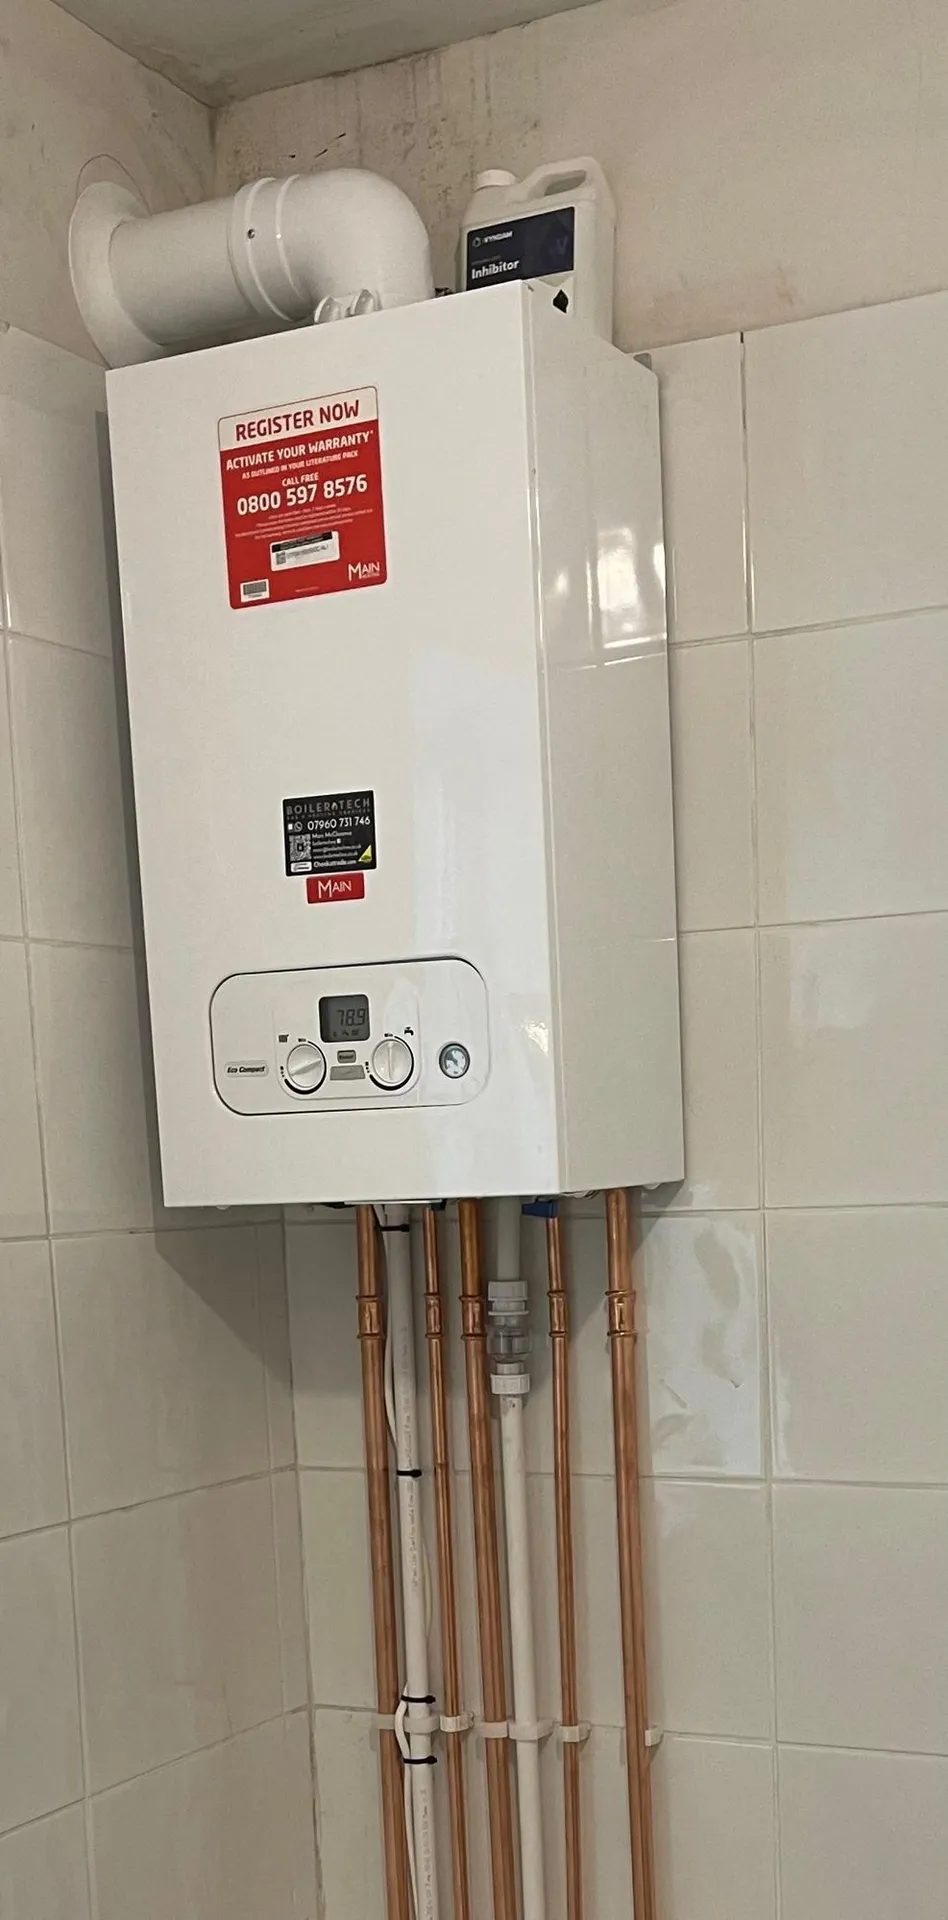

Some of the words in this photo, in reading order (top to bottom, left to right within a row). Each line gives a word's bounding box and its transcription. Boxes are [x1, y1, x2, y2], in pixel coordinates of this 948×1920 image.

[471, 260, 520, 279] Inhibitor
[235, 409, 314, 442] REGISTER
[319, 399, 360, 424] NOW
[226, 450, 275, 471] ACTIVATE
[277, 444, 306, 460] YOUR
[242, 472, 251, 480] AS
[251, 466, 280, 479] OUTLINED
[281, 464, 288, 472] IN
[288, 461, 305, 471] YOUR
[306, 454, 342, 467] LITERATURE
[342, 450, 359, 460] PACK
[281, 476, 300, 487] CALL
[300, 471, 320, 484] FREE
[236, 491, 281, 516] 0800
[286, 483, 318, 507] 597
[323, 474, 368, 499] 8576
[307, 818, 337, 831] 07960
[339, 817, 352, 828] 731
[354, 815, 371, 826] 746
[239, 1066, 265, 1074] Compact
